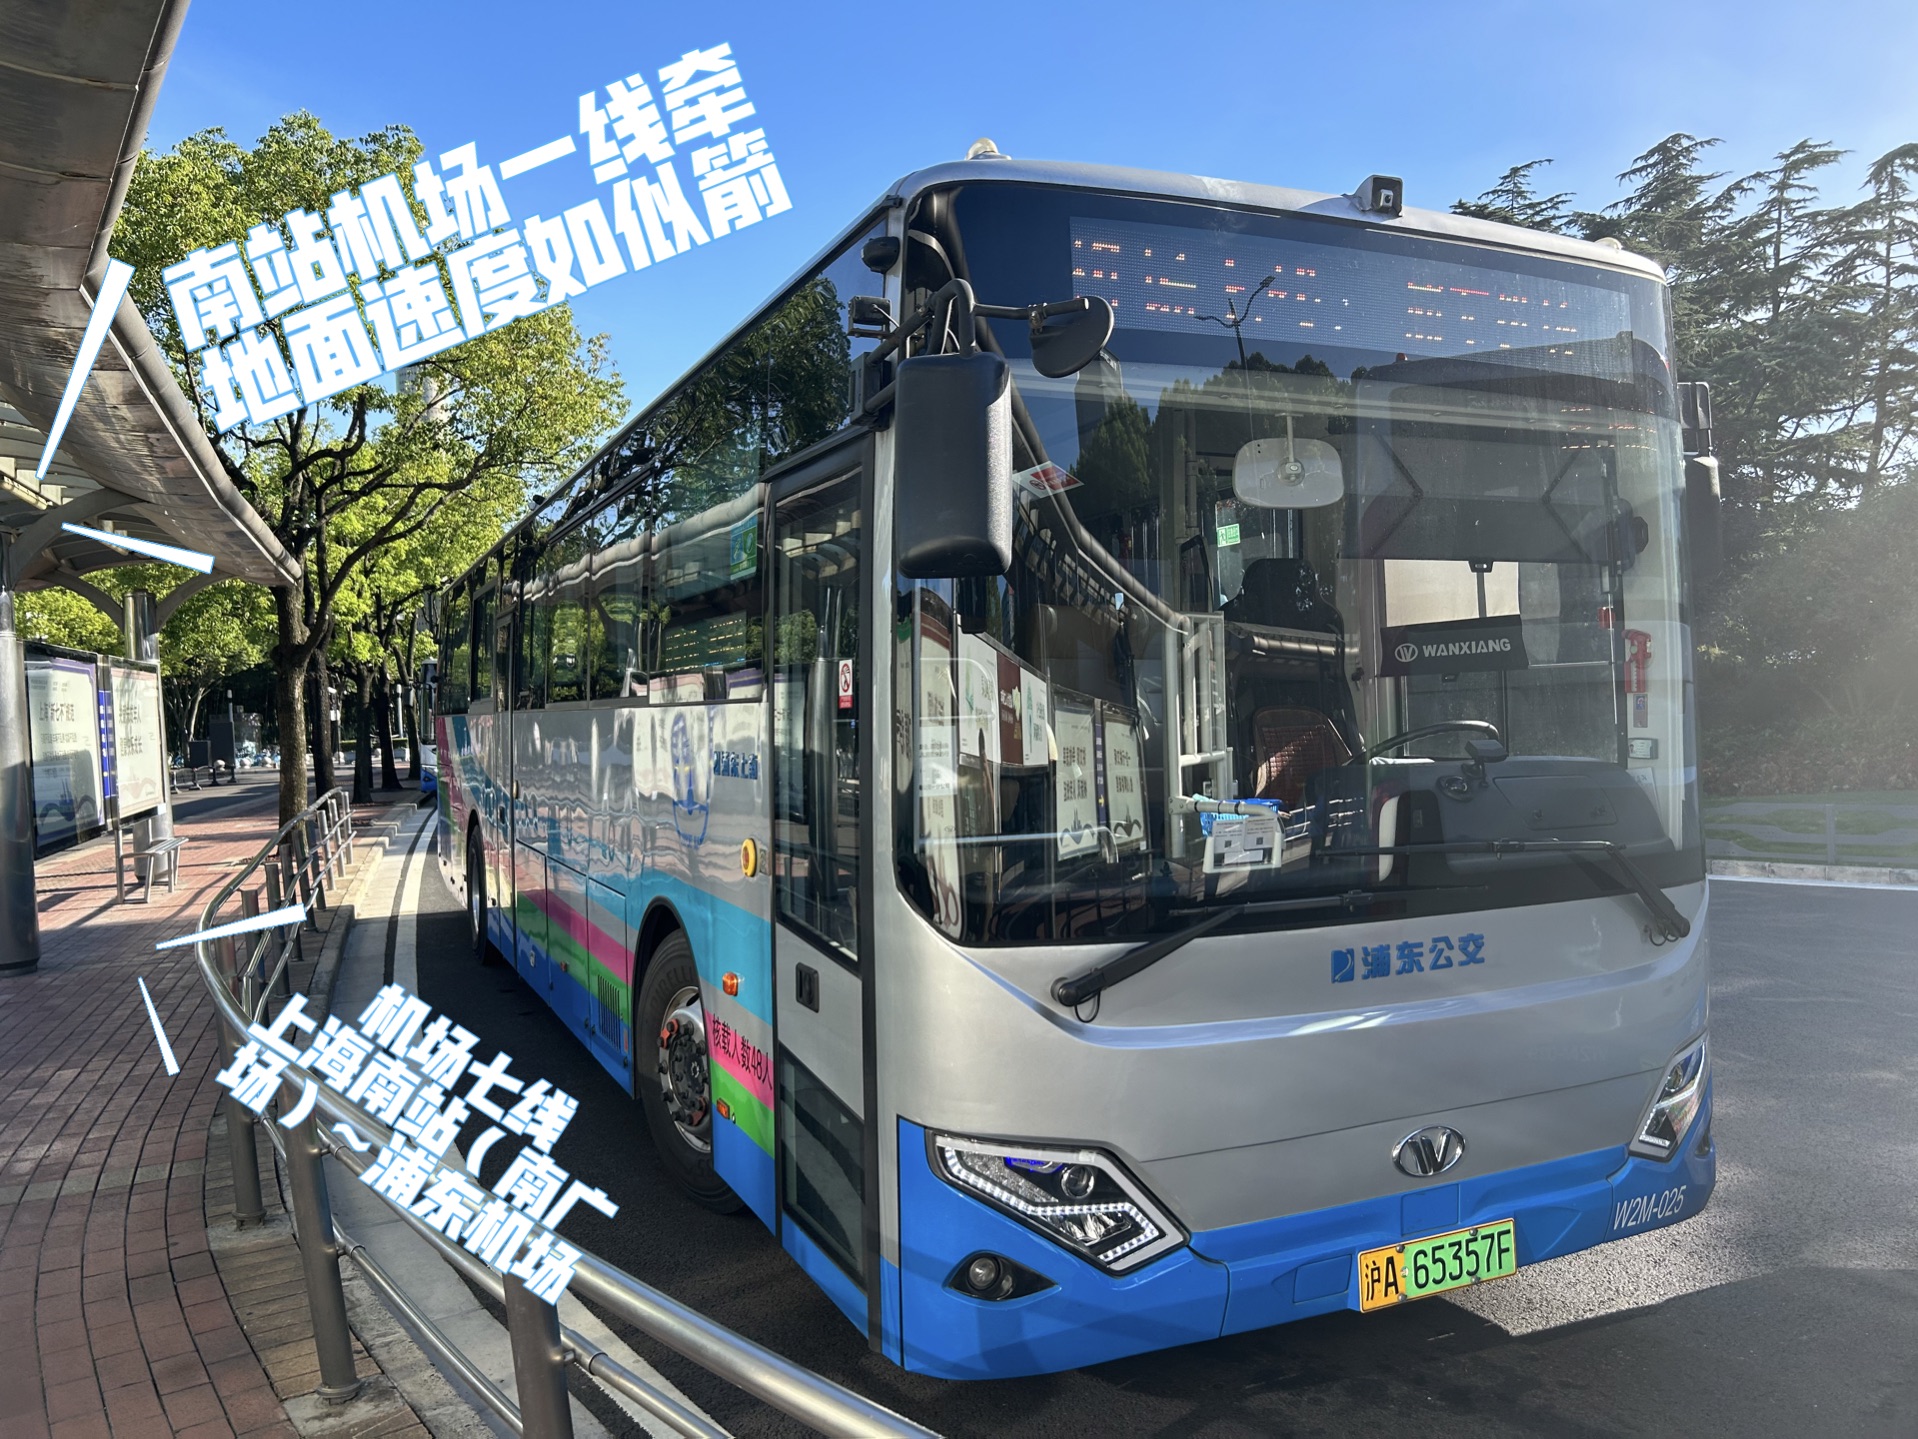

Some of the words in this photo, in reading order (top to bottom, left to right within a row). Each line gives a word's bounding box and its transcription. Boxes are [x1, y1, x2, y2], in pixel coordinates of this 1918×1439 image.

[1422, 638, 1511, 658] WANXIANG
[1361, 933, 1485, 980] 浦东公交
[712, 1012, 773, 1091] 核载人数48人
[1613, 1184, 1687, 1231] W2M-025
